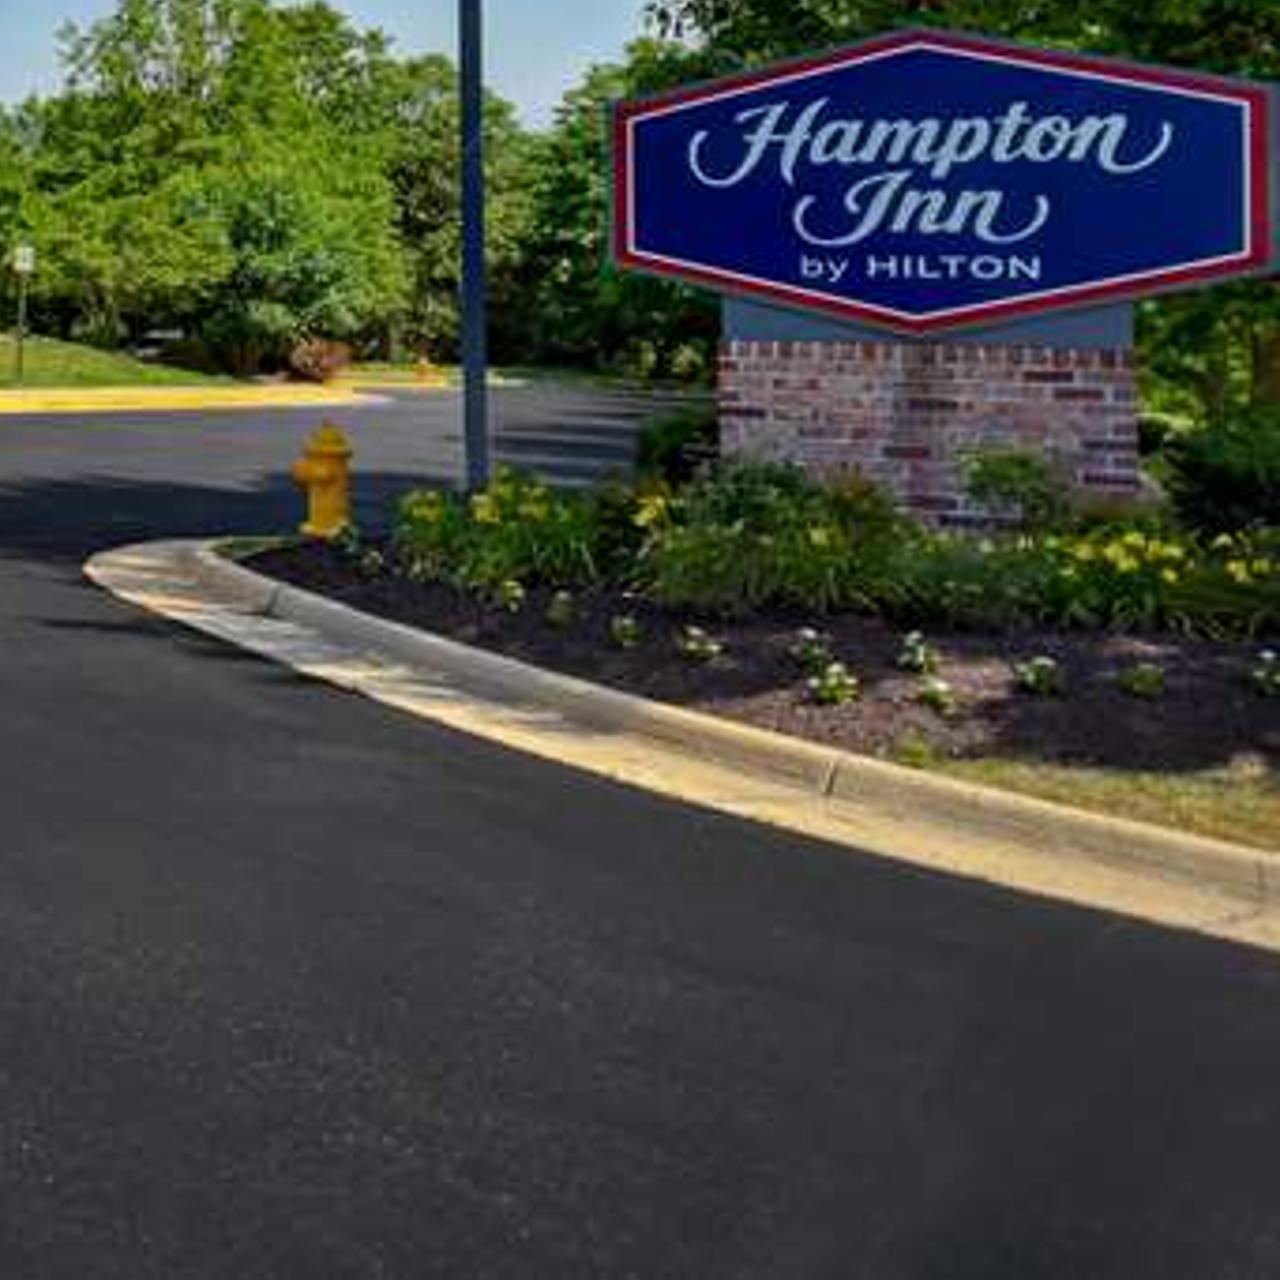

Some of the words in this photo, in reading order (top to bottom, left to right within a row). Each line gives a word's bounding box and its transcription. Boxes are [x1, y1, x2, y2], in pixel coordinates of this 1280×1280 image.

[688, 97, 1173, 187] Hampton
[792, 169, 1049, 246] Inn
[800, 254, 848, 283] by
[866, 254, 1041, 280] HILTON
